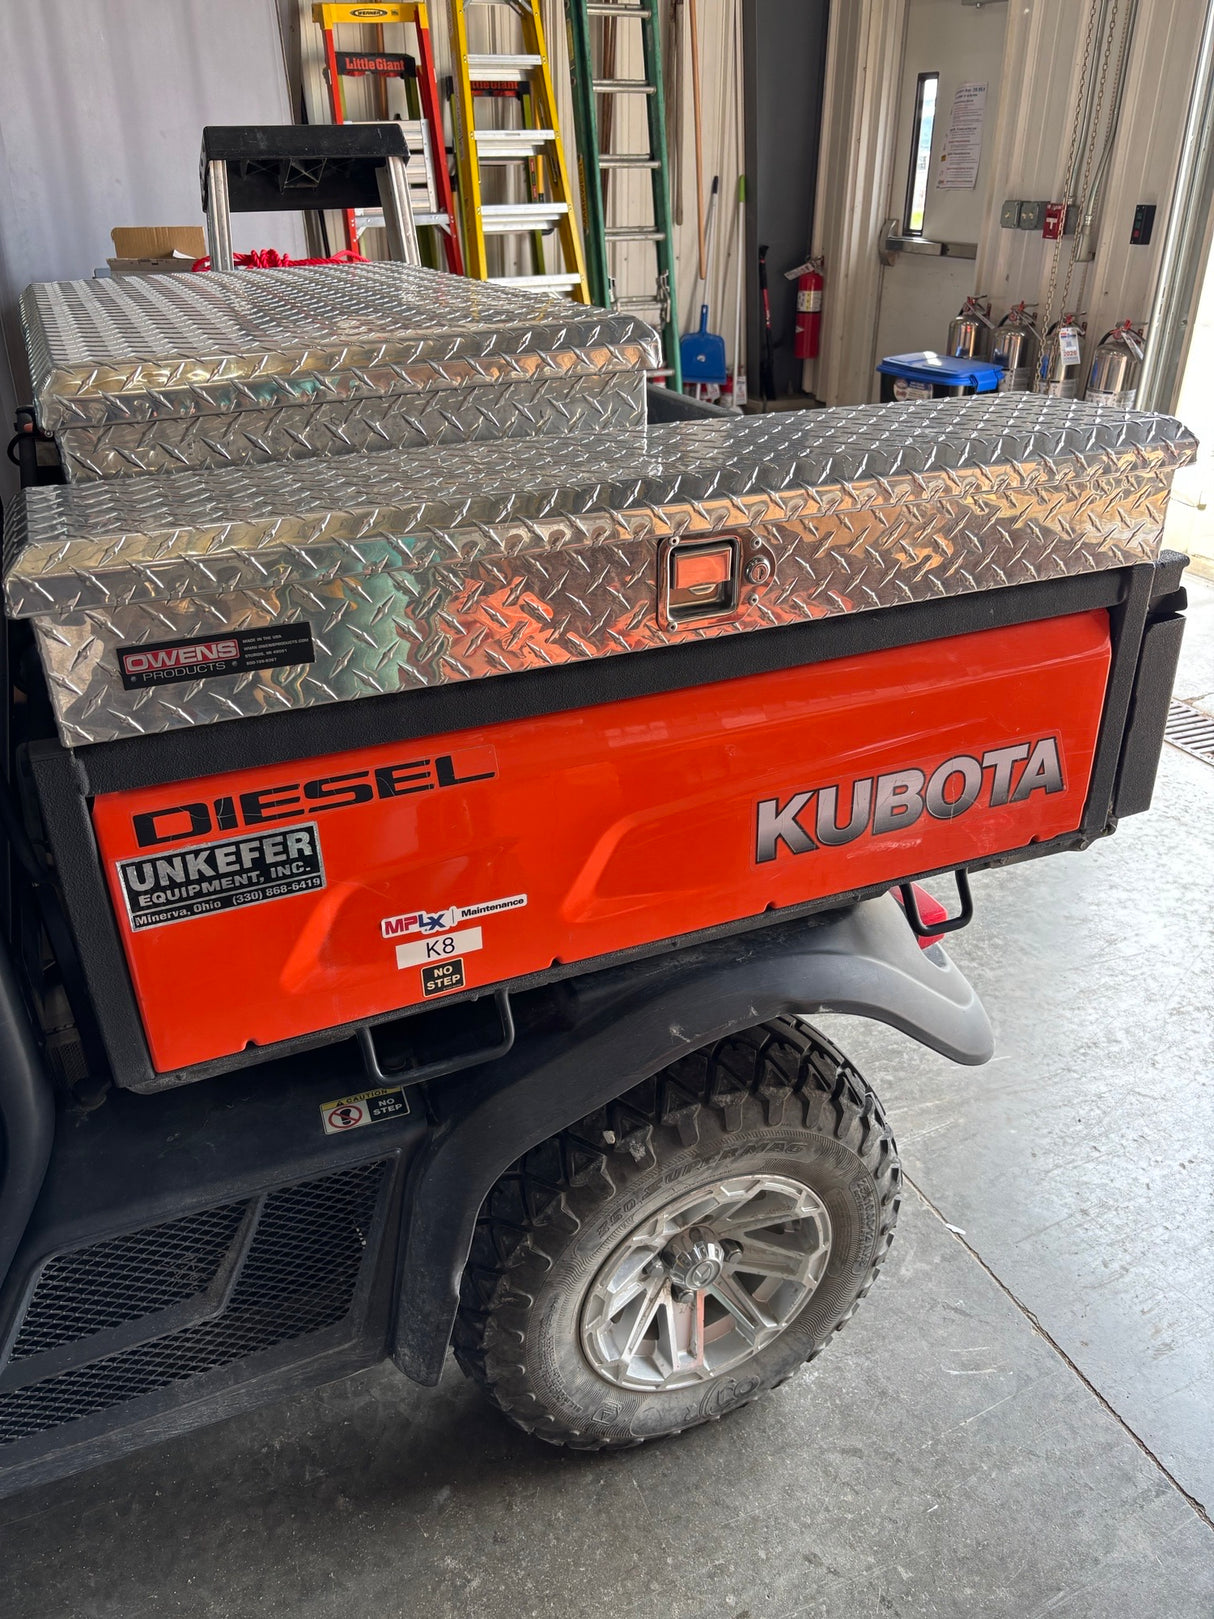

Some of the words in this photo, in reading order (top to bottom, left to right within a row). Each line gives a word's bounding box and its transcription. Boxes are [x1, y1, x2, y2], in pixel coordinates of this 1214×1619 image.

[126, 641, 237, 671] OWENS
[142, 661, 226, 681] PRODUCTS
[132, 755, 496, 848] DIESEL
[756, 736, 1065, 864] KUBOTA
[125, 831, 314, 892] UNKEFER
[138, 870, 265, 907] EQUIPMENT,
[270, 861, 311, 879] INC.
[135, 908, 191, 926] Minerva,
[193, 897, 221, 913] Ohio
[232, 889, 263, 906] (330)
[265, 877, 321, 897] 868-6419
[384, 913, 447, 935] MPLX
[461, 898, 525, 918] Maintenance
[426, 936, 455, 958] K8
[426, 974, 461, 991] STEP
[433, 965, 453, 978] NO
[346, 1089, 388, 1103] CAUTION
[378, 1098, 395, 1107] NO
[372, 1103, 403, 1116] STEP
